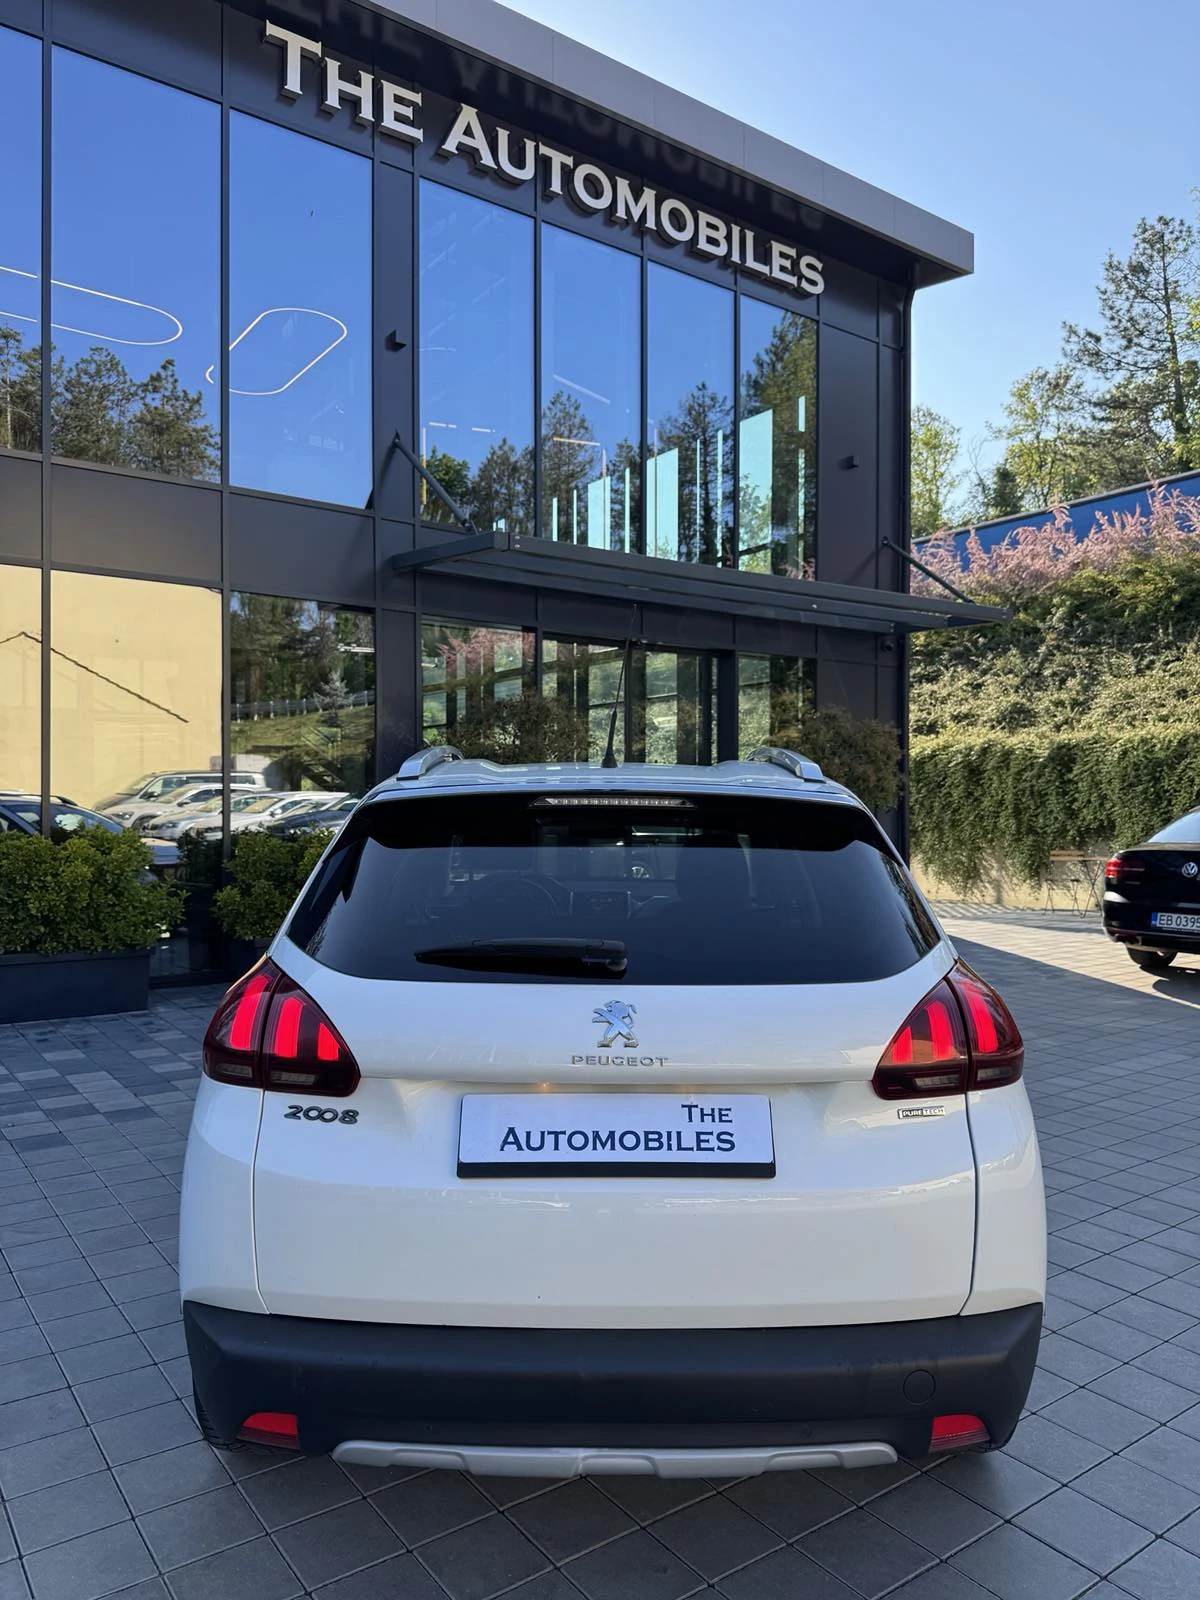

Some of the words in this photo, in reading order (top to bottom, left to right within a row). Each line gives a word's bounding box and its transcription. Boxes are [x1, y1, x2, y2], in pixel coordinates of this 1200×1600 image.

[264, 19, 424, 145] THE
[439, 104, 825, 295] AUTOMOBILES
[1158, 914, 1173, 926] EB
[571, 1055, 669, 1067] PEUGEOT
[284, 1104, 359, 1125] 2008
[681, 1104, 733, 1124] THE
[500, 1126, 736, 1152] AUTOMOBILES
